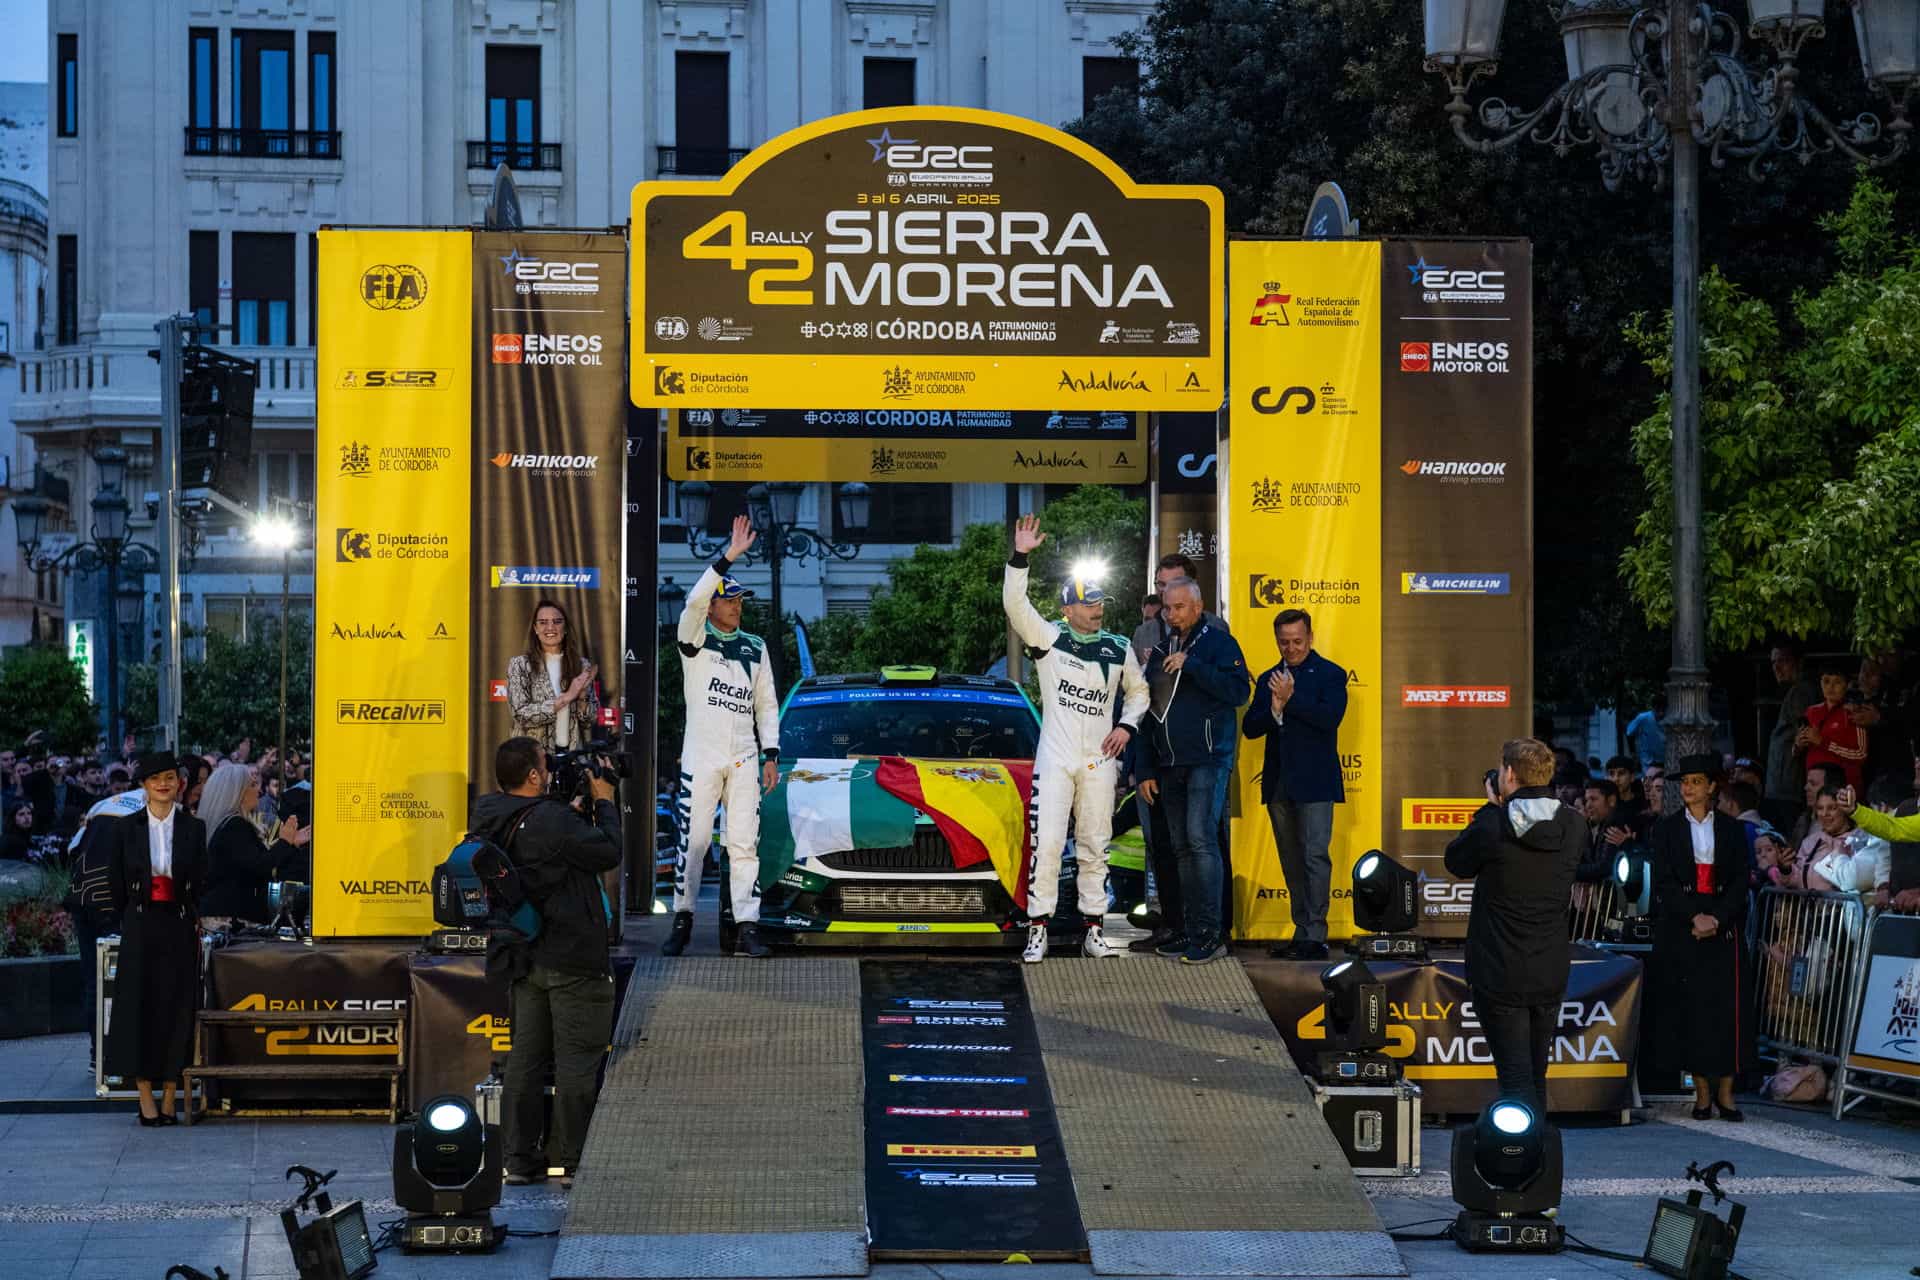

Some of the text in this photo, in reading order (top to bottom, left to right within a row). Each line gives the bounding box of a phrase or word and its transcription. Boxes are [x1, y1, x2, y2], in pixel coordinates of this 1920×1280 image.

[887, 145, 993, 168] ERC
[857, 193, 1001, 204] 3 al 6 ABRIL 2025
[751, 231, 814, 244] RALLY
[825, 210, 1110, 255] SIERRA
[682, 211, 814, 305] 42
[515, 261, 599, 280] ERC
[1422, 270, 1504, 288] ERC
[825, 263, 1174, 308] MORENA
[1296, 296, 1360, 306] Real Federación
[1304, 307, 1353, 318] Española de
[989, 321, 1049, 330] PATRIMONIO
[1297, 317, 1360, 327] Automovilismo
[875, 317, 985, 340] CÓRDOBA
[988, 331, 1057, 341] HUMANIDAD
[524, 334, 602, 352] ENEOS
[1432, 342, 1509, 360] ENEOS
[525, 354, 602, 366] MOTOR OIL
[1432, 361, 1509, 373] MOTOR OIL
[690, 372, 749, 383] Diputación
[914, 371, 976, 382] AYUNTAMIENTO
[1058, 370, 1152, 392] Andalucía
[690, 383, 749, 393] de Córdoba
[914, 382, 966, 394] DE CÓRDOBA
[956, 419, 1012, 427] HUMANIDAD
[379, 447, 451, 459] AYUNTAMIENTO
[715, 451, 762, 461] Diputación
[897, 451, 947, 460] AYUNTAMIENTO
[379, 459, 439, 471] DE CÓRDOBA
[1012, 450, 1088, 469] Andalucía
[1290, 483, 1361, 496] AYUNTAMIENTO
[1290, 494, 1349, 506] DE CÓRDOBA
[377, 533, 448, 547] Diputación
[377, 547, 449, 558] de Córdoba
[522, 572, 592, 584] MICHELIN
[1432, 579, 1501, 589] MICHELIN
[1290, 579, 1360, 594] Diputación
[1290, 592, 1360, 604] de Córdoba
[329, 621, 406, 640] Andalucía
[1405, 690, 1507, 702] MRF TYRES
[357, 702, 426, 721] Recalvi
[1058, 697, 1105, 717] SKODA
[381, 800, 431, 809] CATEDRAL
[381, 810, 393, 819] DE
